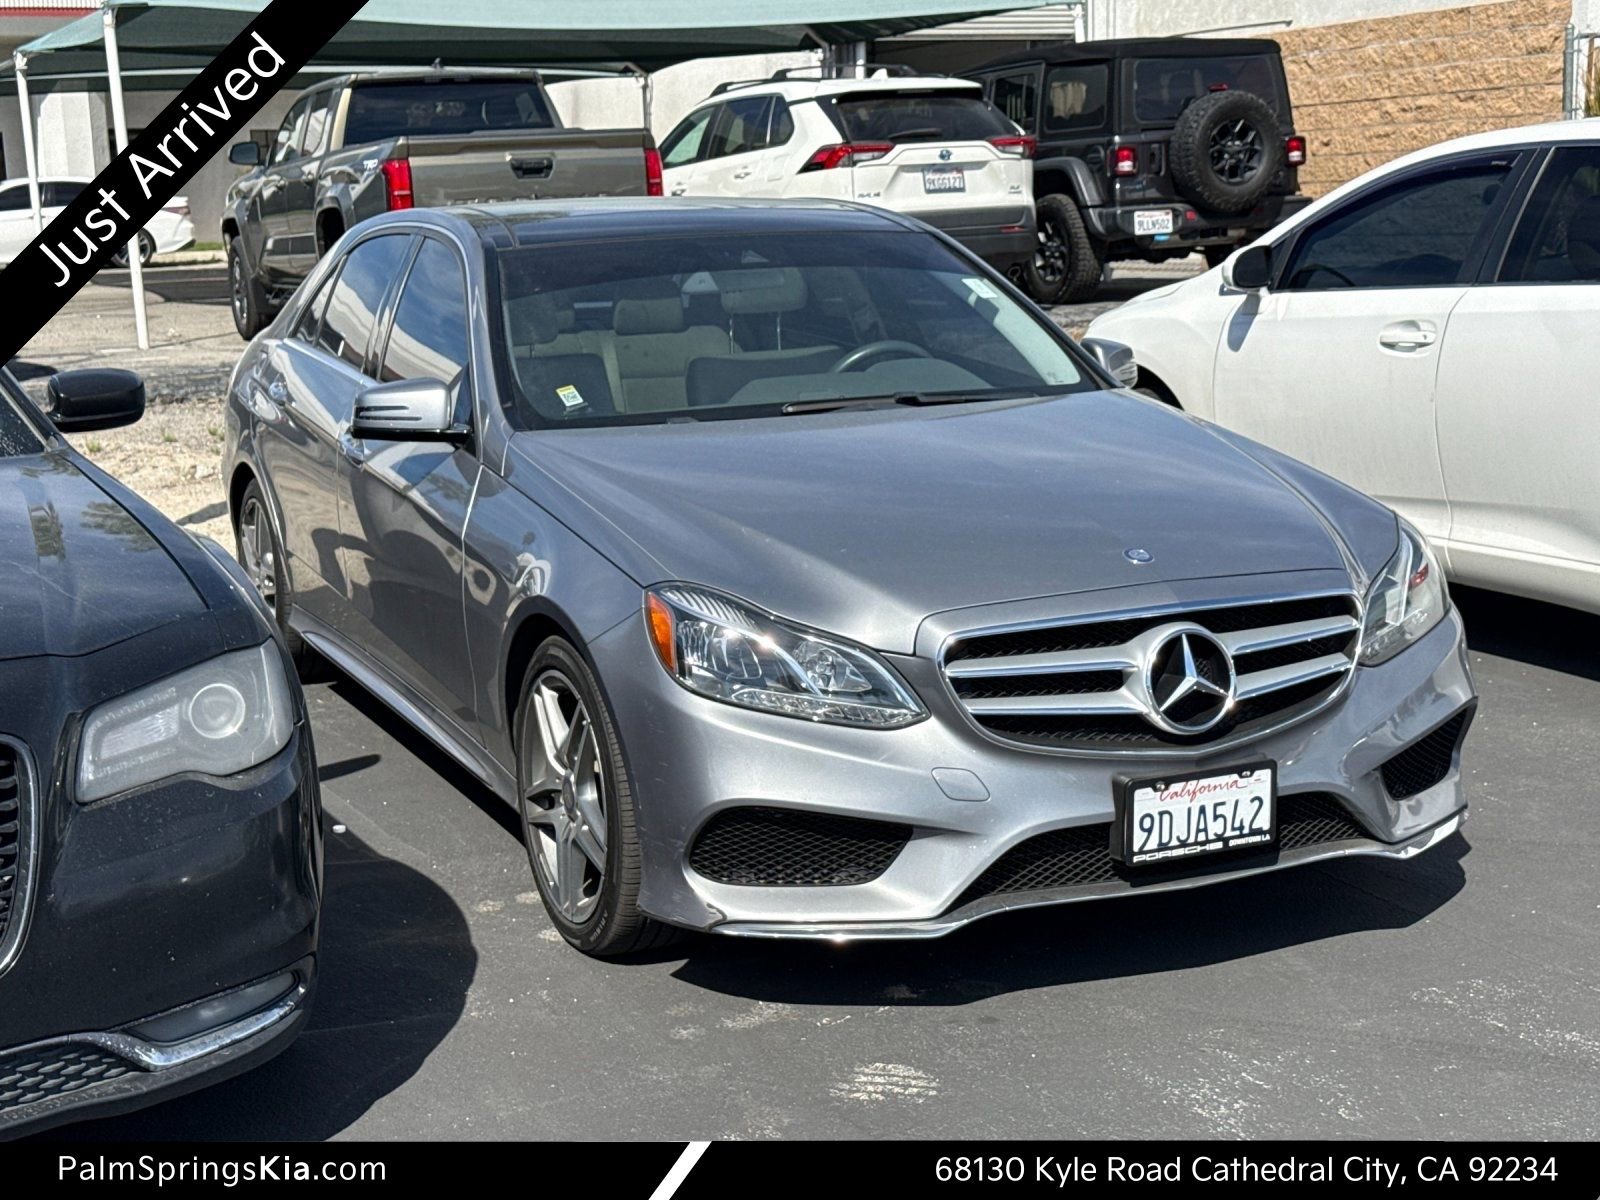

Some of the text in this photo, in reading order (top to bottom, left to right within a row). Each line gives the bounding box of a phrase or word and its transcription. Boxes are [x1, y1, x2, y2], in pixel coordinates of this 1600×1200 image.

[1159, 778, 1248, 803] California
[1138, 795, 1264, 852] 9DJA542
[1133, 841, 1223, 863] PORSCHE
